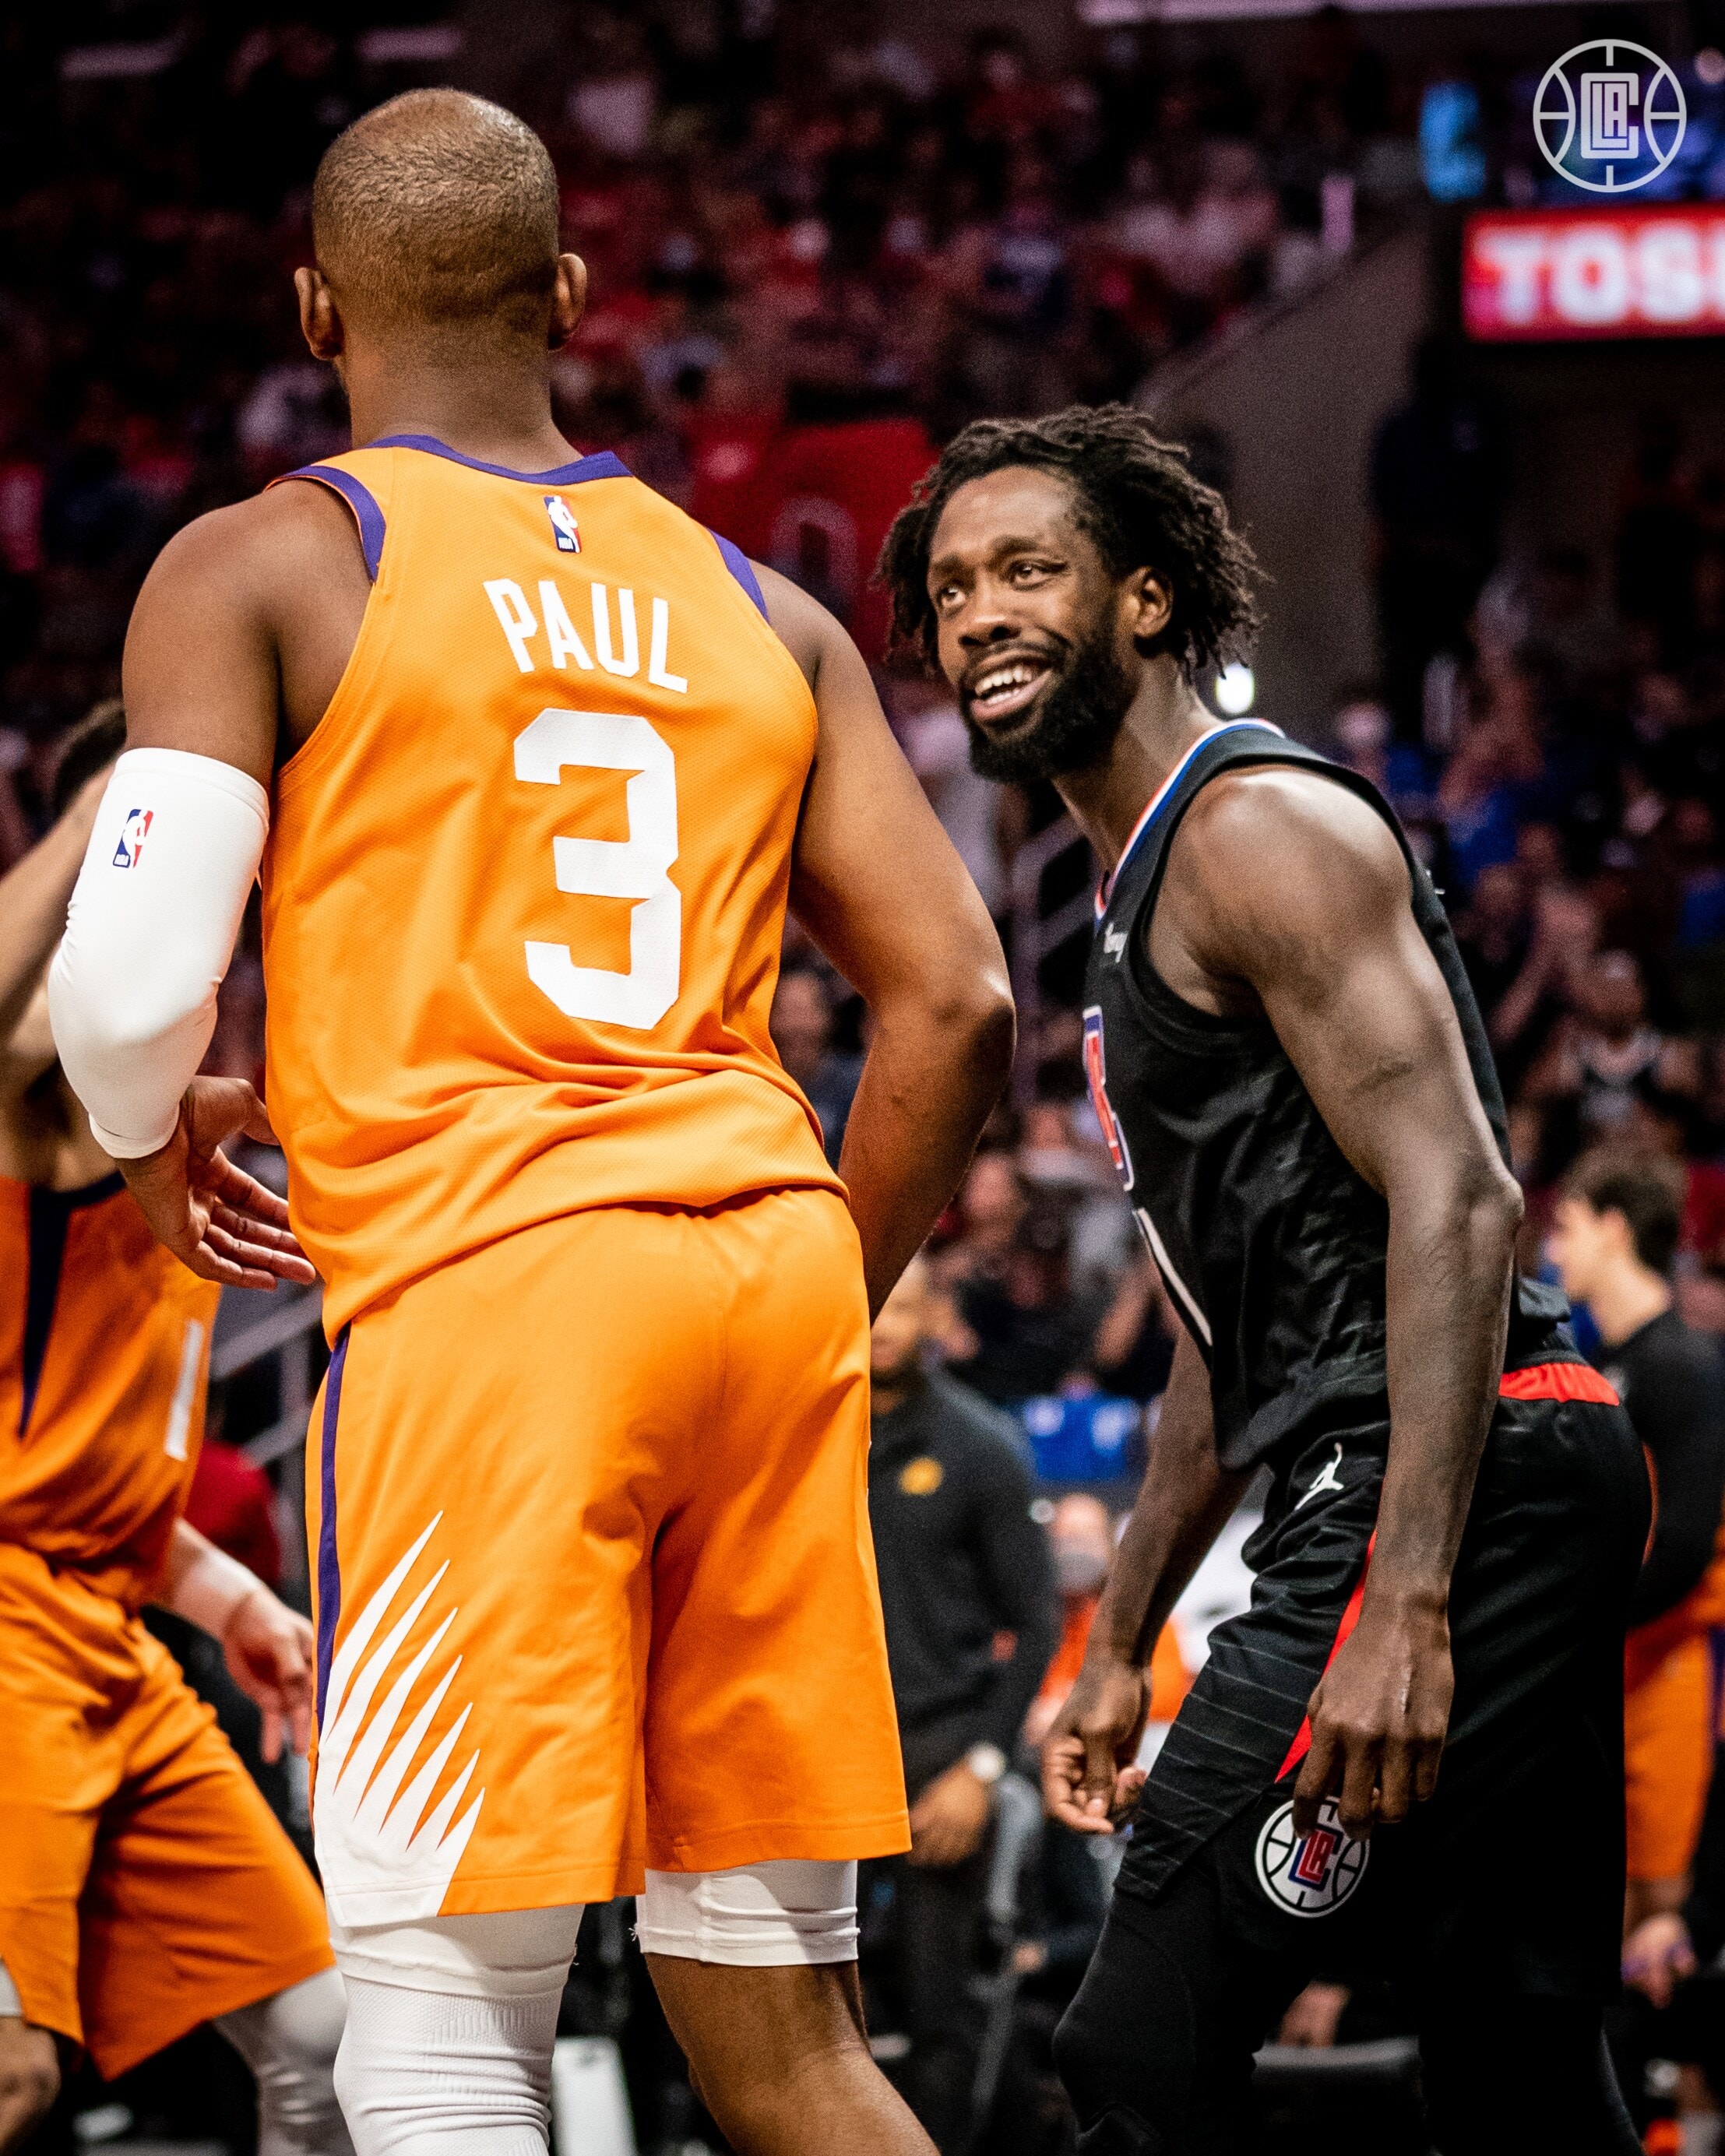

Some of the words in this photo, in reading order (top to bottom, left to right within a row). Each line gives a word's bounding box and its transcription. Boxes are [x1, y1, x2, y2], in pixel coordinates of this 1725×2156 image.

[1474, 220, 1725, 327] TOS
[482, 578, 688, 694] PAUL
[513, 707, 681, 1030] 3
